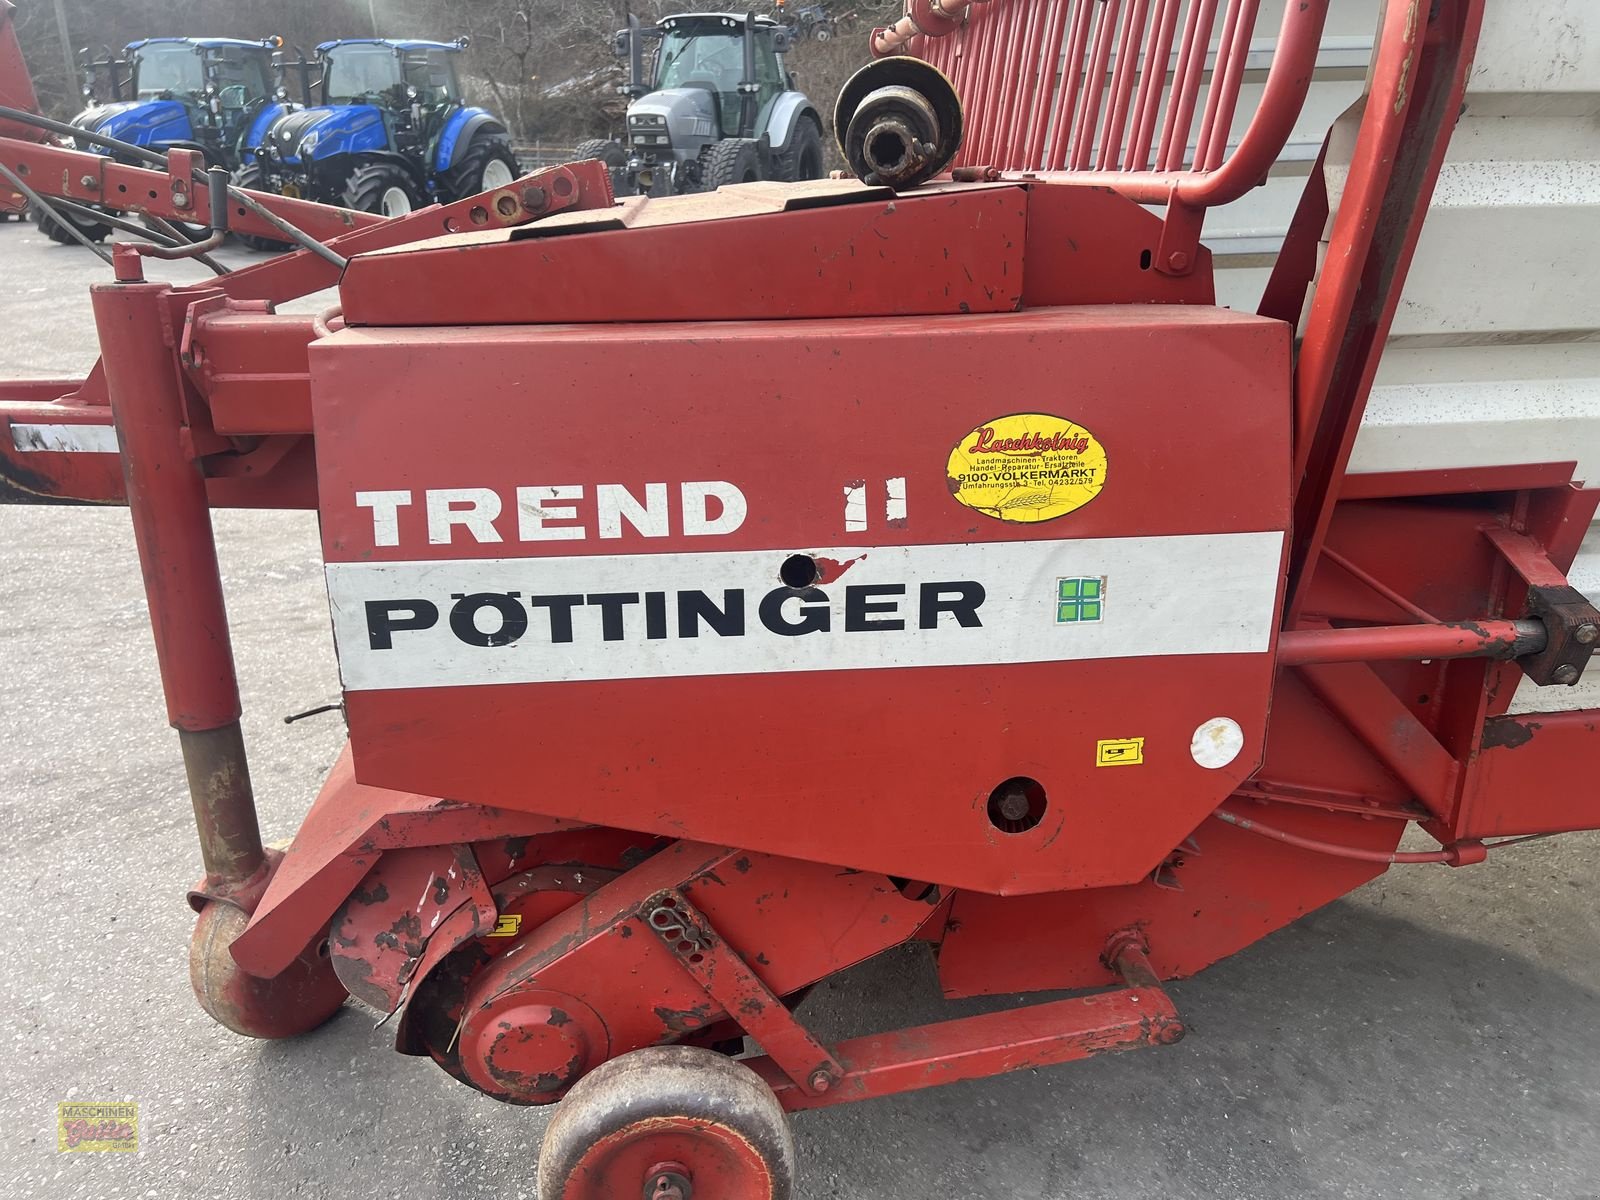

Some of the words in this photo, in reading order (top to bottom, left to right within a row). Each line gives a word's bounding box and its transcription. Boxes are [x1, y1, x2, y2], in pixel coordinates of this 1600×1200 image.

[355, 481, 748, 546] TREND
[1048, 477, 1093, 486] 04232/579
[364, 580, 986, 650] PÖTTINGER
